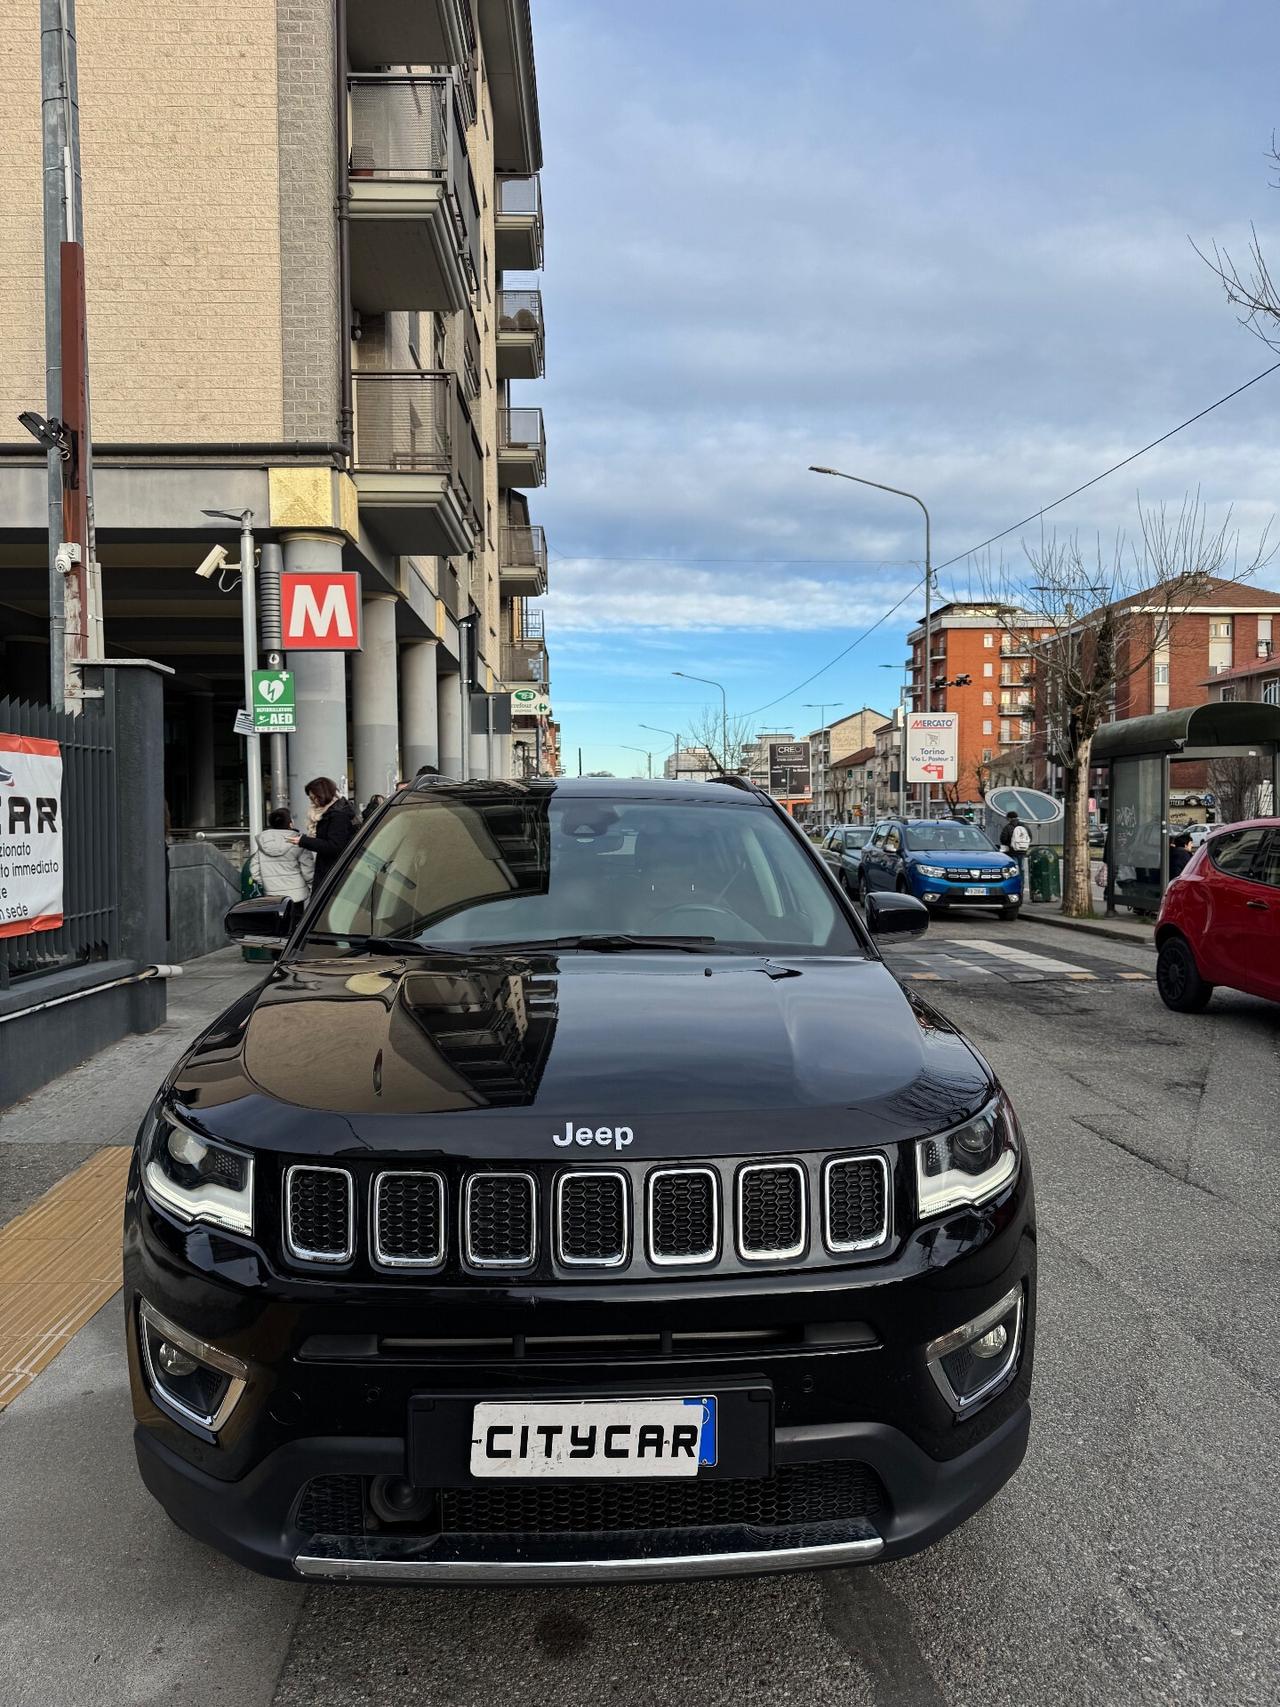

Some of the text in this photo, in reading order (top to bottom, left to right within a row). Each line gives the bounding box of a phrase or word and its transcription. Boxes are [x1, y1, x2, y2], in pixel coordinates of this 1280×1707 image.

[289, 585, 353, 637] M
[270, 713, 293, 724] AED
[0, 796, 57, 834] AR
[12, 859, 59, 876] immediato
[6, 903, 28, 918] sede
[553, 1122, 634, 1150] Jeep
[486, 1425, 698, 1459] CITYCAR
